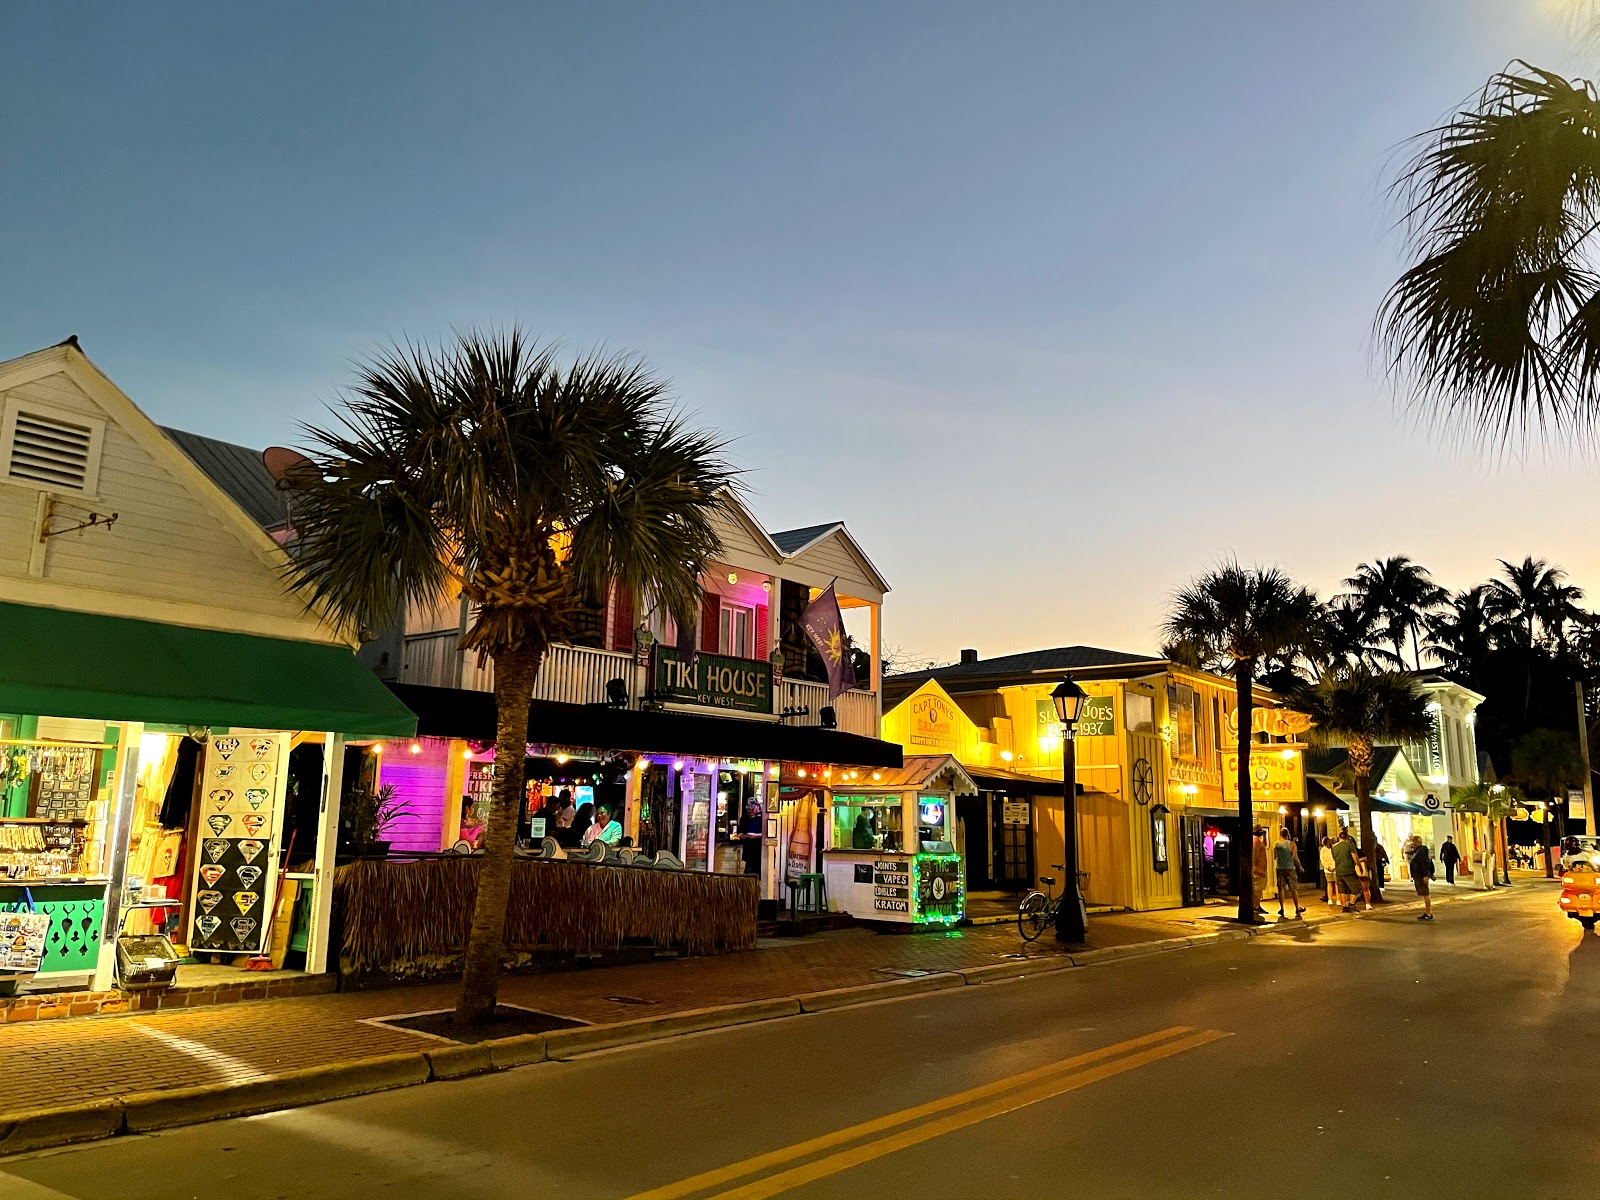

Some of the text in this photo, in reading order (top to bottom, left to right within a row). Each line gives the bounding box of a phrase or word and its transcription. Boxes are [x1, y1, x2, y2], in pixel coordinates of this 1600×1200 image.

[707, 664, 766, 698] HOUSE
[697, 693, 735, 708] KEY WEST
[1082, 705, 1114, 721] JOE'S
[468, 780, 493, 793] TIKI
[875, 861, 898, 871] JOINTS
[882, 874, 907, 885] VAPES
[875, 899, 907, 911] KRATOM
